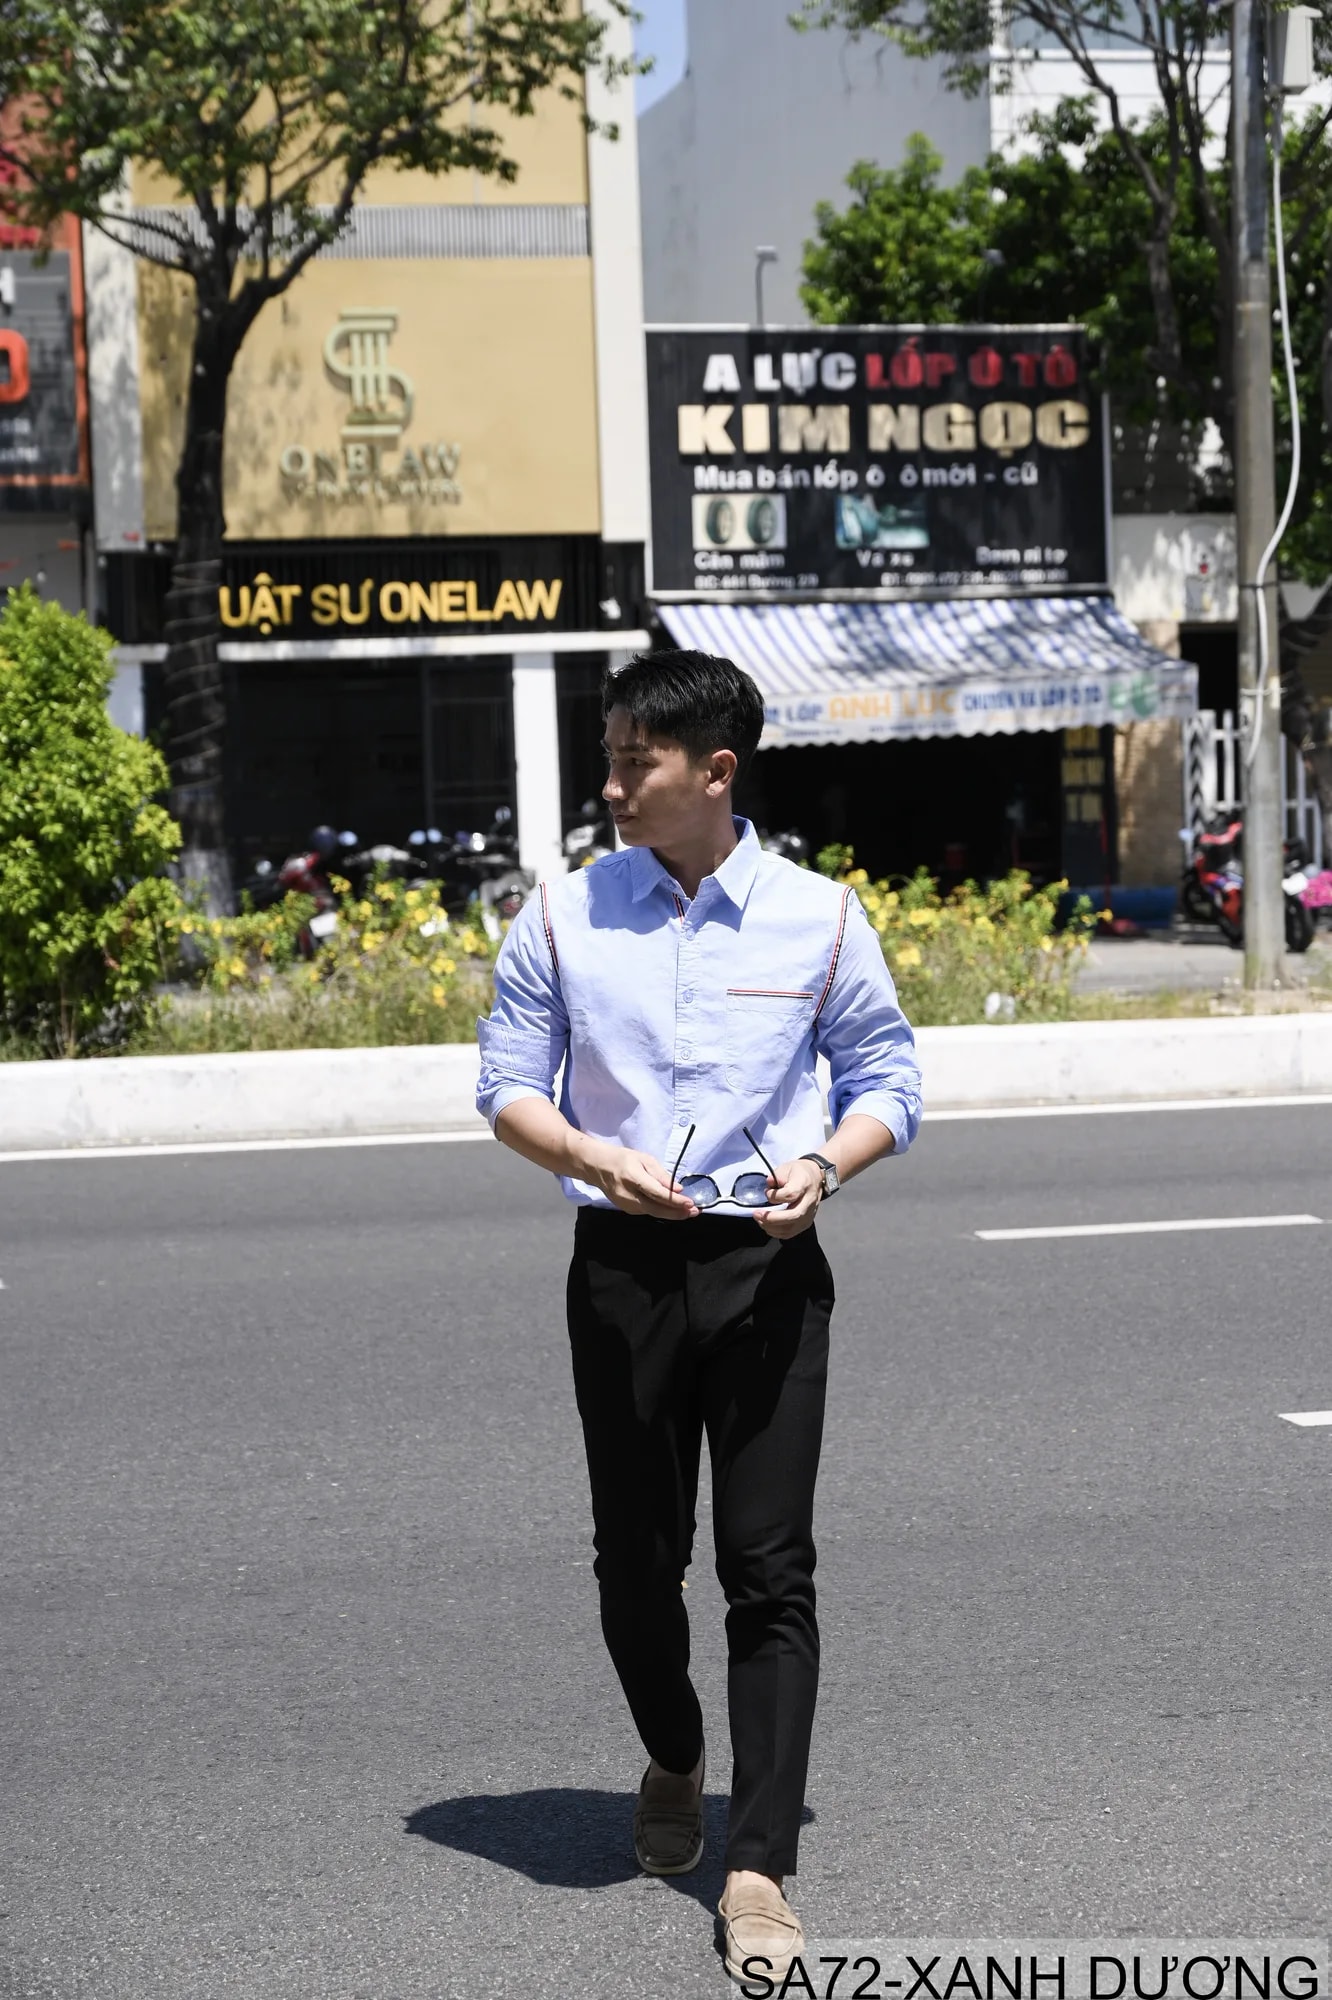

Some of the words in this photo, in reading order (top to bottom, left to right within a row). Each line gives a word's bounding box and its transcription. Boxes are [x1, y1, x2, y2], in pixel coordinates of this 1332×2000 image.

[703, 354, 741, 392] A
[754, 348, 857, 398] LỰC
[865, 337, 956, 389] LỐP
[678, 402, 850, 455] KIM
[868, 399, 1090, 459] NGỌC
[694, 464, 753, 490] Mua
[757, 463, 811, 490] bán
[813, 458, 858, 492] lốp
[865, 463, 885, 487] ô
[219, 572, 302, 635] UẬT
[311, 578, 374, 625] SƯ
[379, 578, 563, 624] ONELAW
[829, 695, 891, 720] ANH
